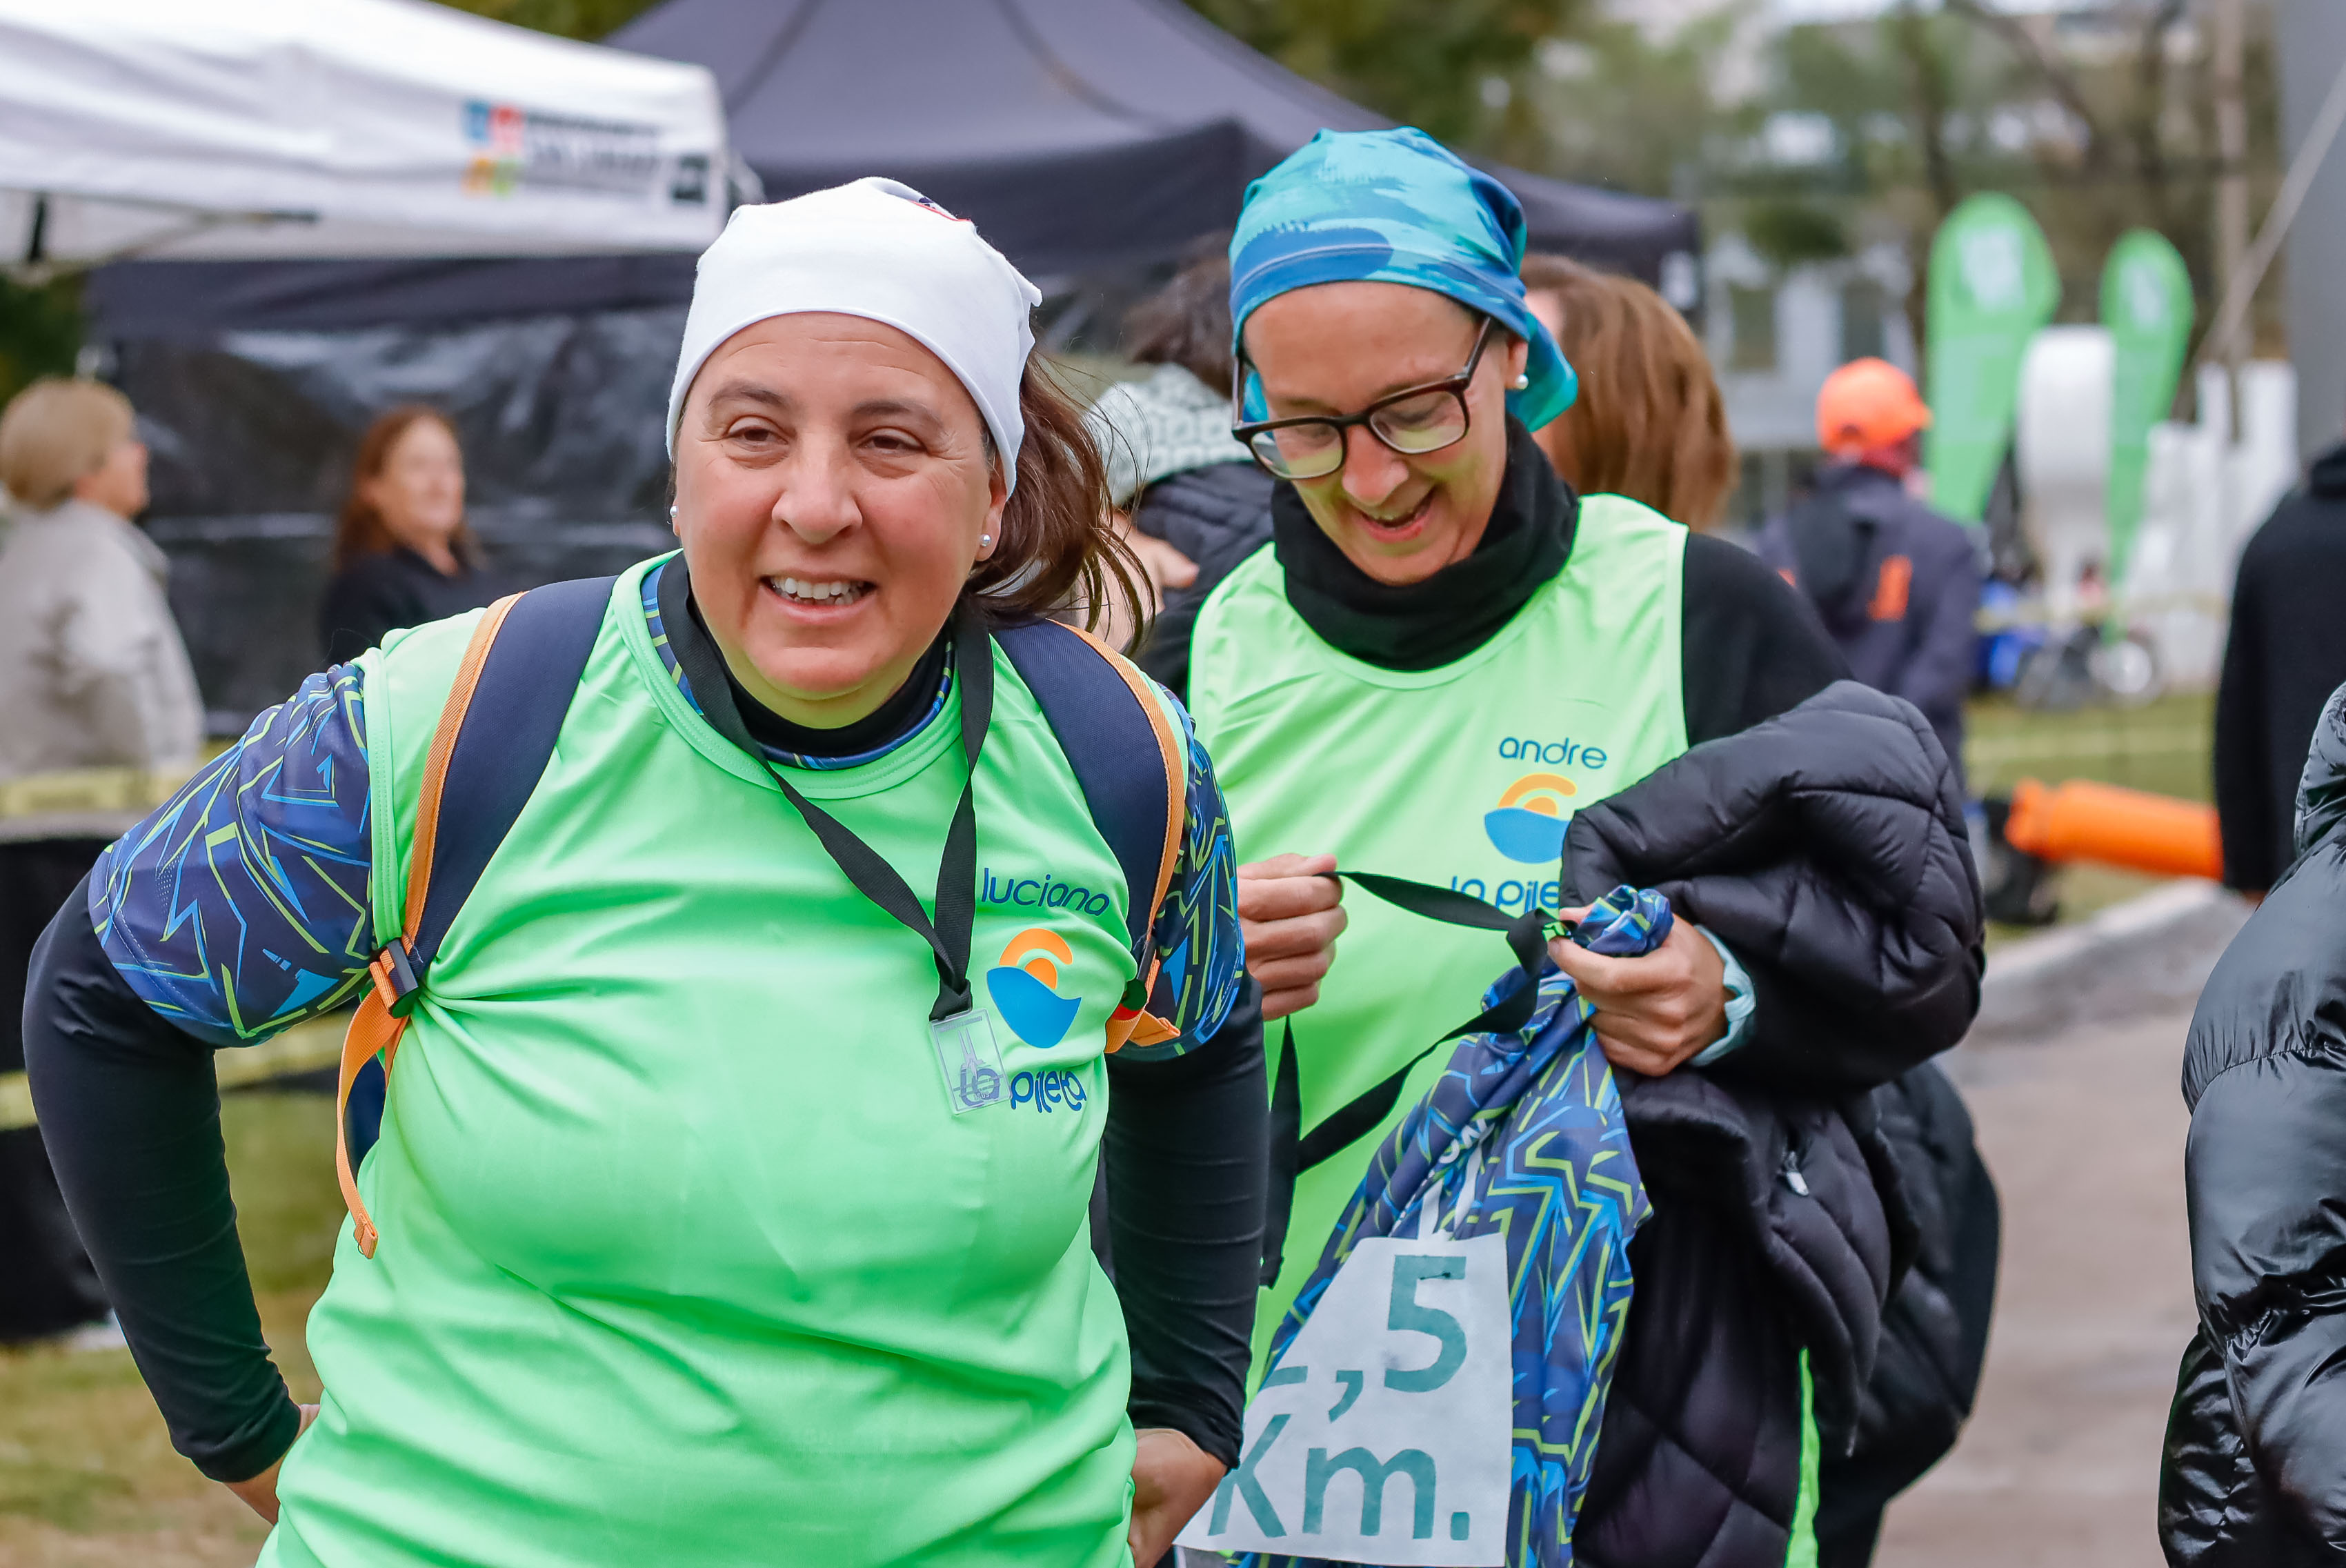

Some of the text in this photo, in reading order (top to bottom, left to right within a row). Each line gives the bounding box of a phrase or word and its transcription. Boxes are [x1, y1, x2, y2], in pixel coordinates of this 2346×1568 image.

[1498, 736, 1608, 769] andre
[981, 867, 1111, 917] luciana
[1494, 880, 1561, 915] pile
[1009, 1070, 1088, 1113] pileta
[1207, 1413, 1471, 1541] Km.
